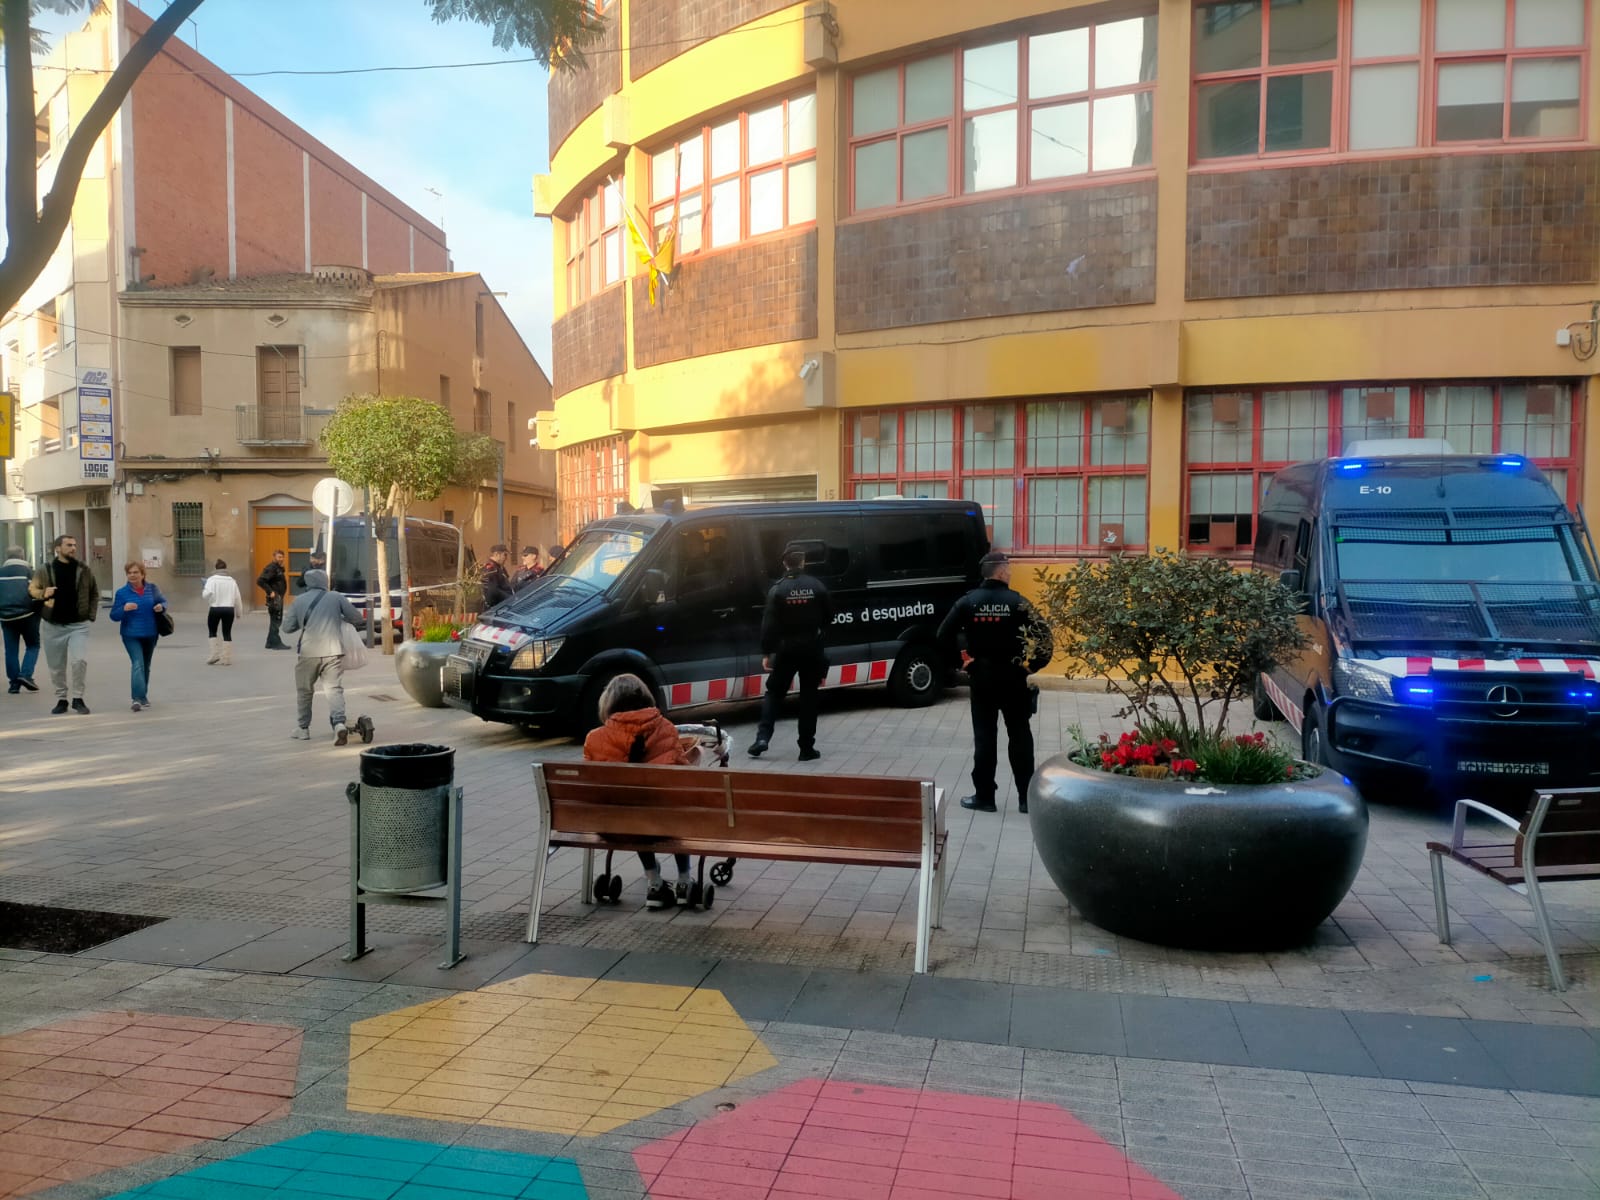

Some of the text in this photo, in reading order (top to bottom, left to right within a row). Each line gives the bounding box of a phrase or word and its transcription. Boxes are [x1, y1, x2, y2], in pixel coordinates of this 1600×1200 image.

[84, 463, 109, 473] LOGIC
[84, 471, 109, 479] CONTROL
[1359, 486, 1392, 495] E-10
[789, 588, 815, 597] OLICIA
[973, 603, 1011, 613] OLICIA
